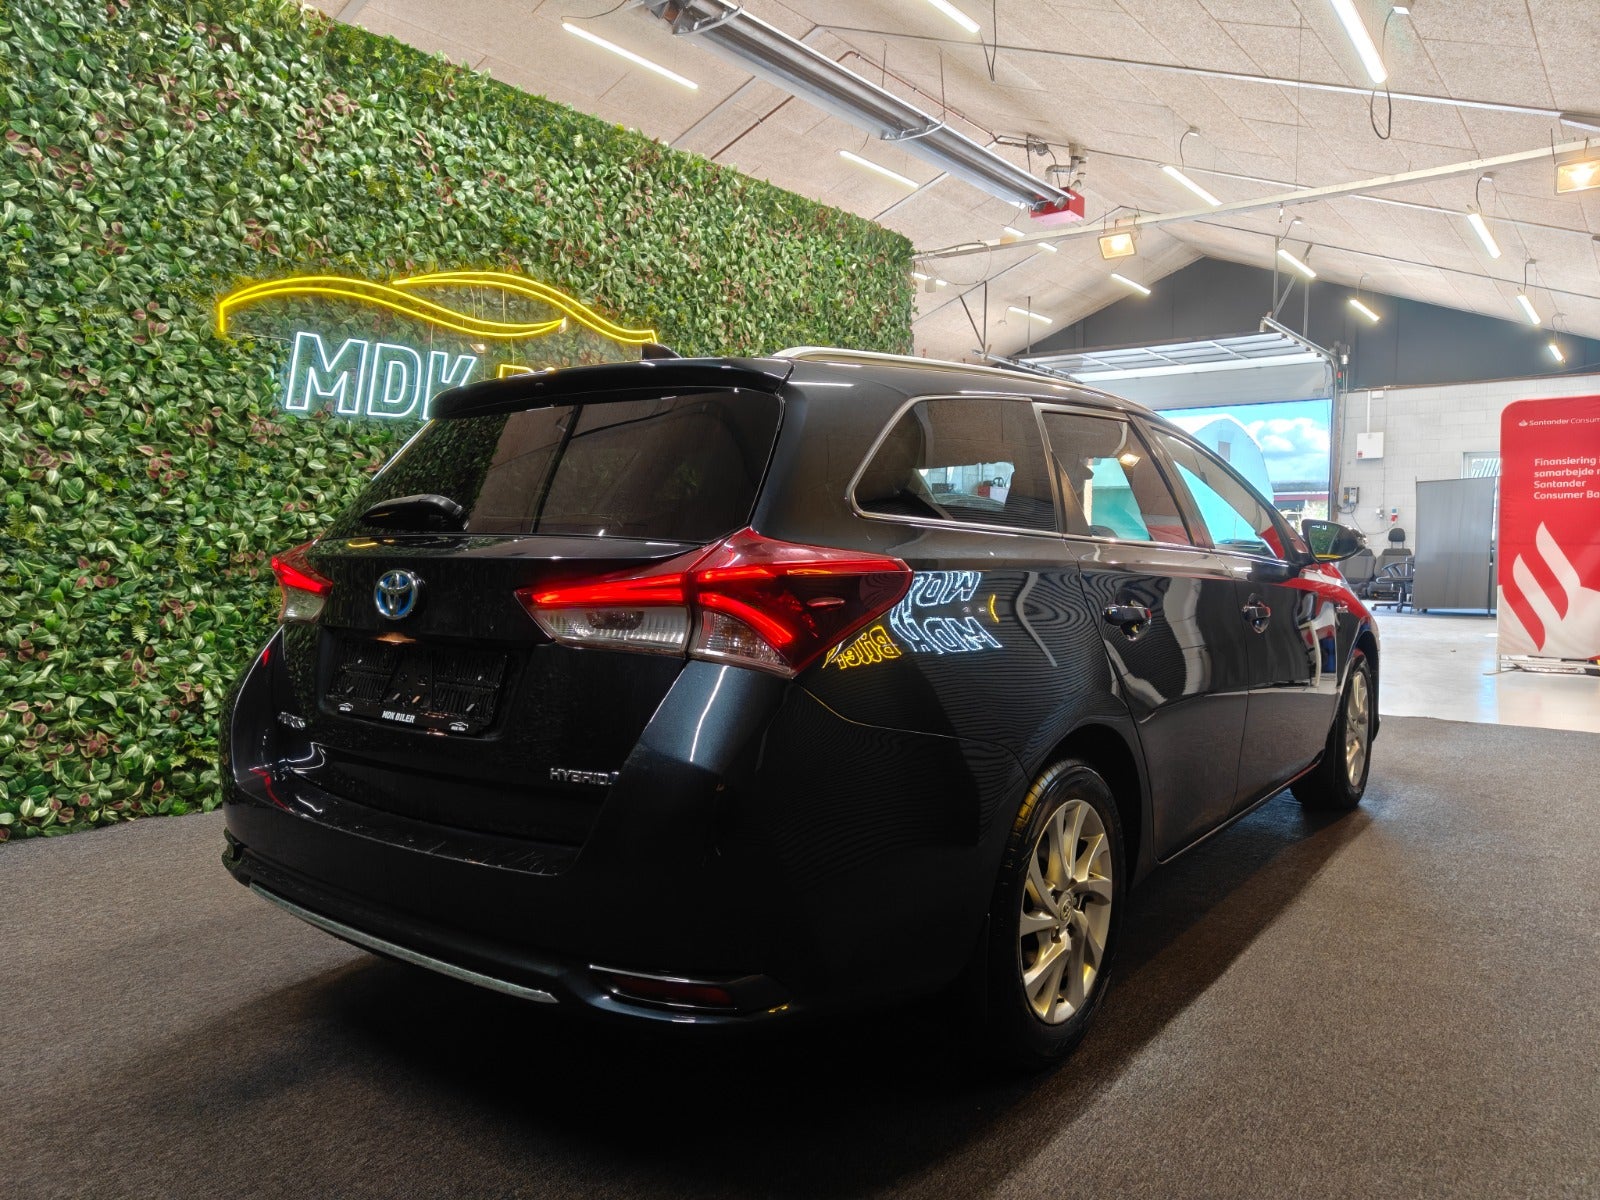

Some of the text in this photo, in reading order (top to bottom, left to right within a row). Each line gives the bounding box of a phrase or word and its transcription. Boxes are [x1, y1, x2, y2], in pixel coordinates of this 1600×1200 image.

[285, 330, 477, 421] MDK
[1534, 456, 1596, 466] Finansiering
[1534, 468, 1594, 477] samarbejde
[1534, 479, 1586, 489] Santander
[1533, 491, 1584, 500] Consumer
